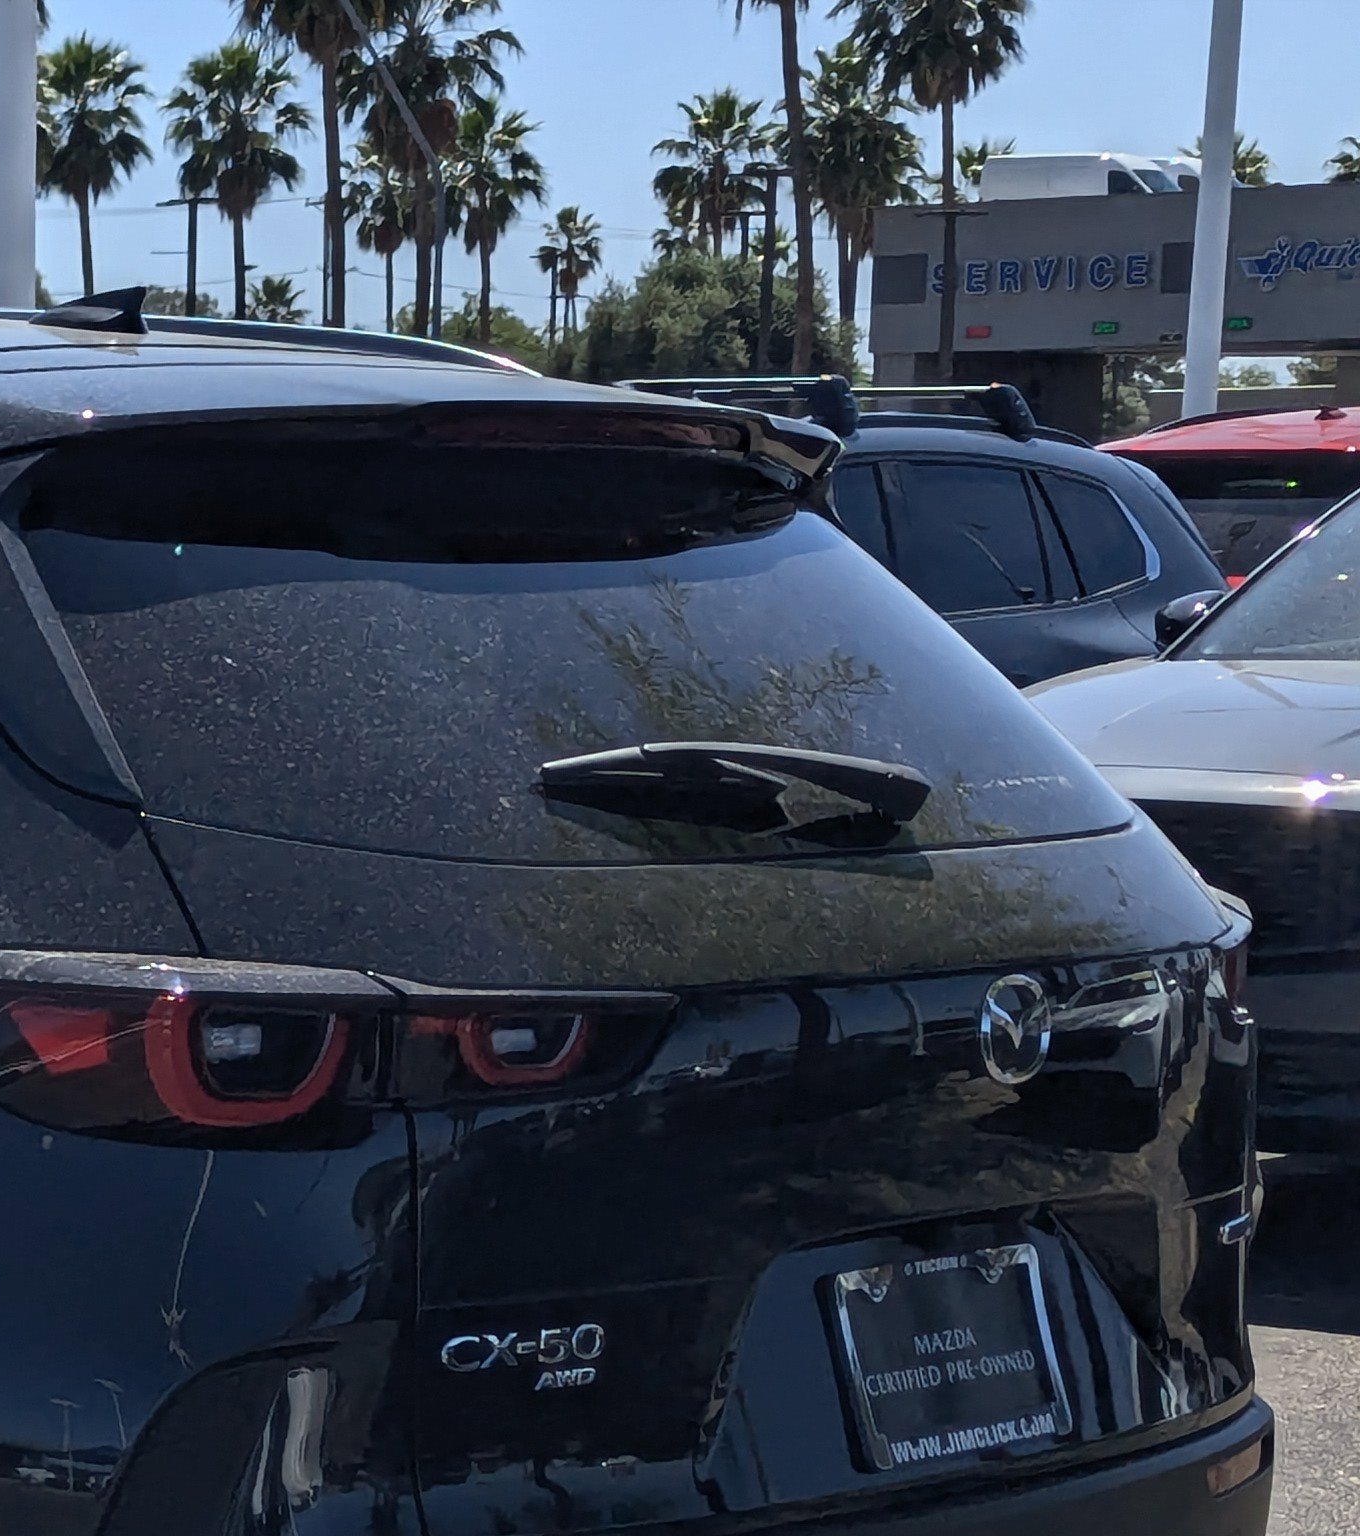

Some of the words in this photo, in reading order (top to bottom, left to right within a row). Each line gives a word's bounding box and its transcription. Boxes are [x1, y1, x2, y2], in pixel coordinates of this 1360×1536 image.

[914, 1256, 959, 1275] TUCSON
[440, 1323, 607, 1373] CX-50
[913, 1326, 978, 1357] MAZDA
[534, 1366, 597, 1392] AWD
[865, 1364, 943, 1398] CERTIFIED
[946, 1348, 1036, 1384] PRE-OWNED
[890, 1412, 1057, 1465] WWW.JIMCLICK.COM
